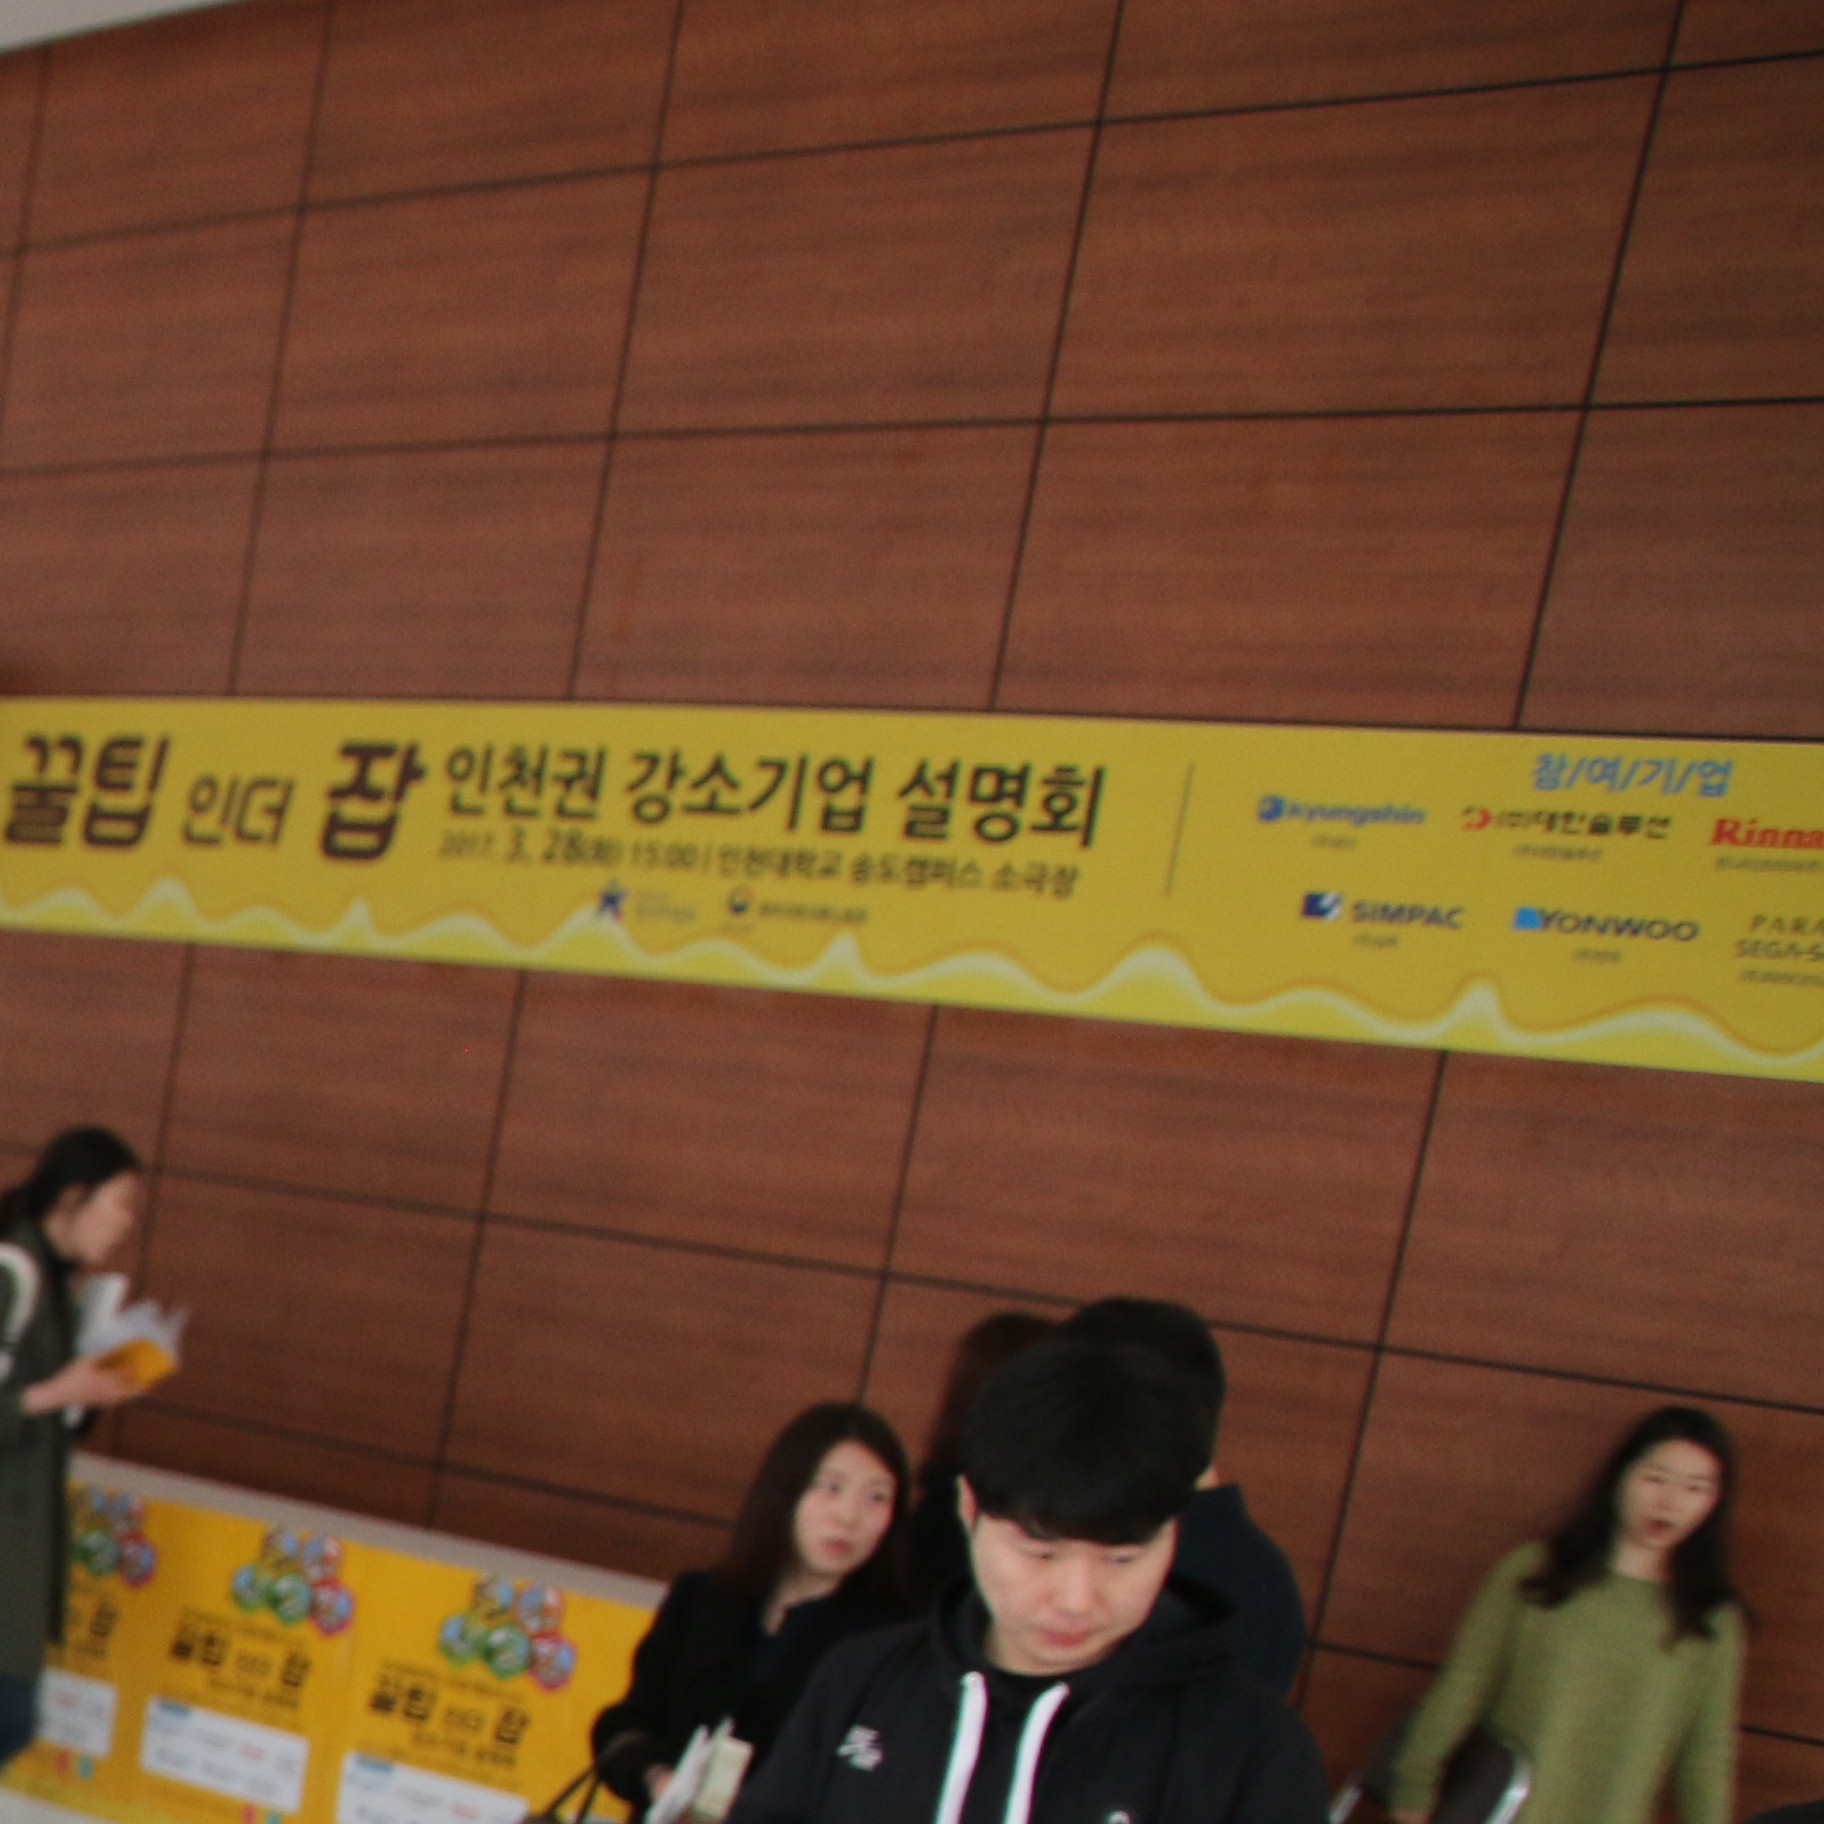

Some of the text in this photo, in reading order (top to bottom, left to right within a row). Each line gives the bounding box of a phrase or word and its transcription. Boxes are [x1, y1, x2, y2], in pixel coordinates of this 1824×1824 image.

[1532, 752, 1735, 799] 참/여/기/업
[3, 734, 1105, 861] 꿀팁 인더 잡 인천권 강소기업 설명회
[1352, 900, 1466, 929] SIMPAC
[1539, 907, 1702, 943] YONWOO
